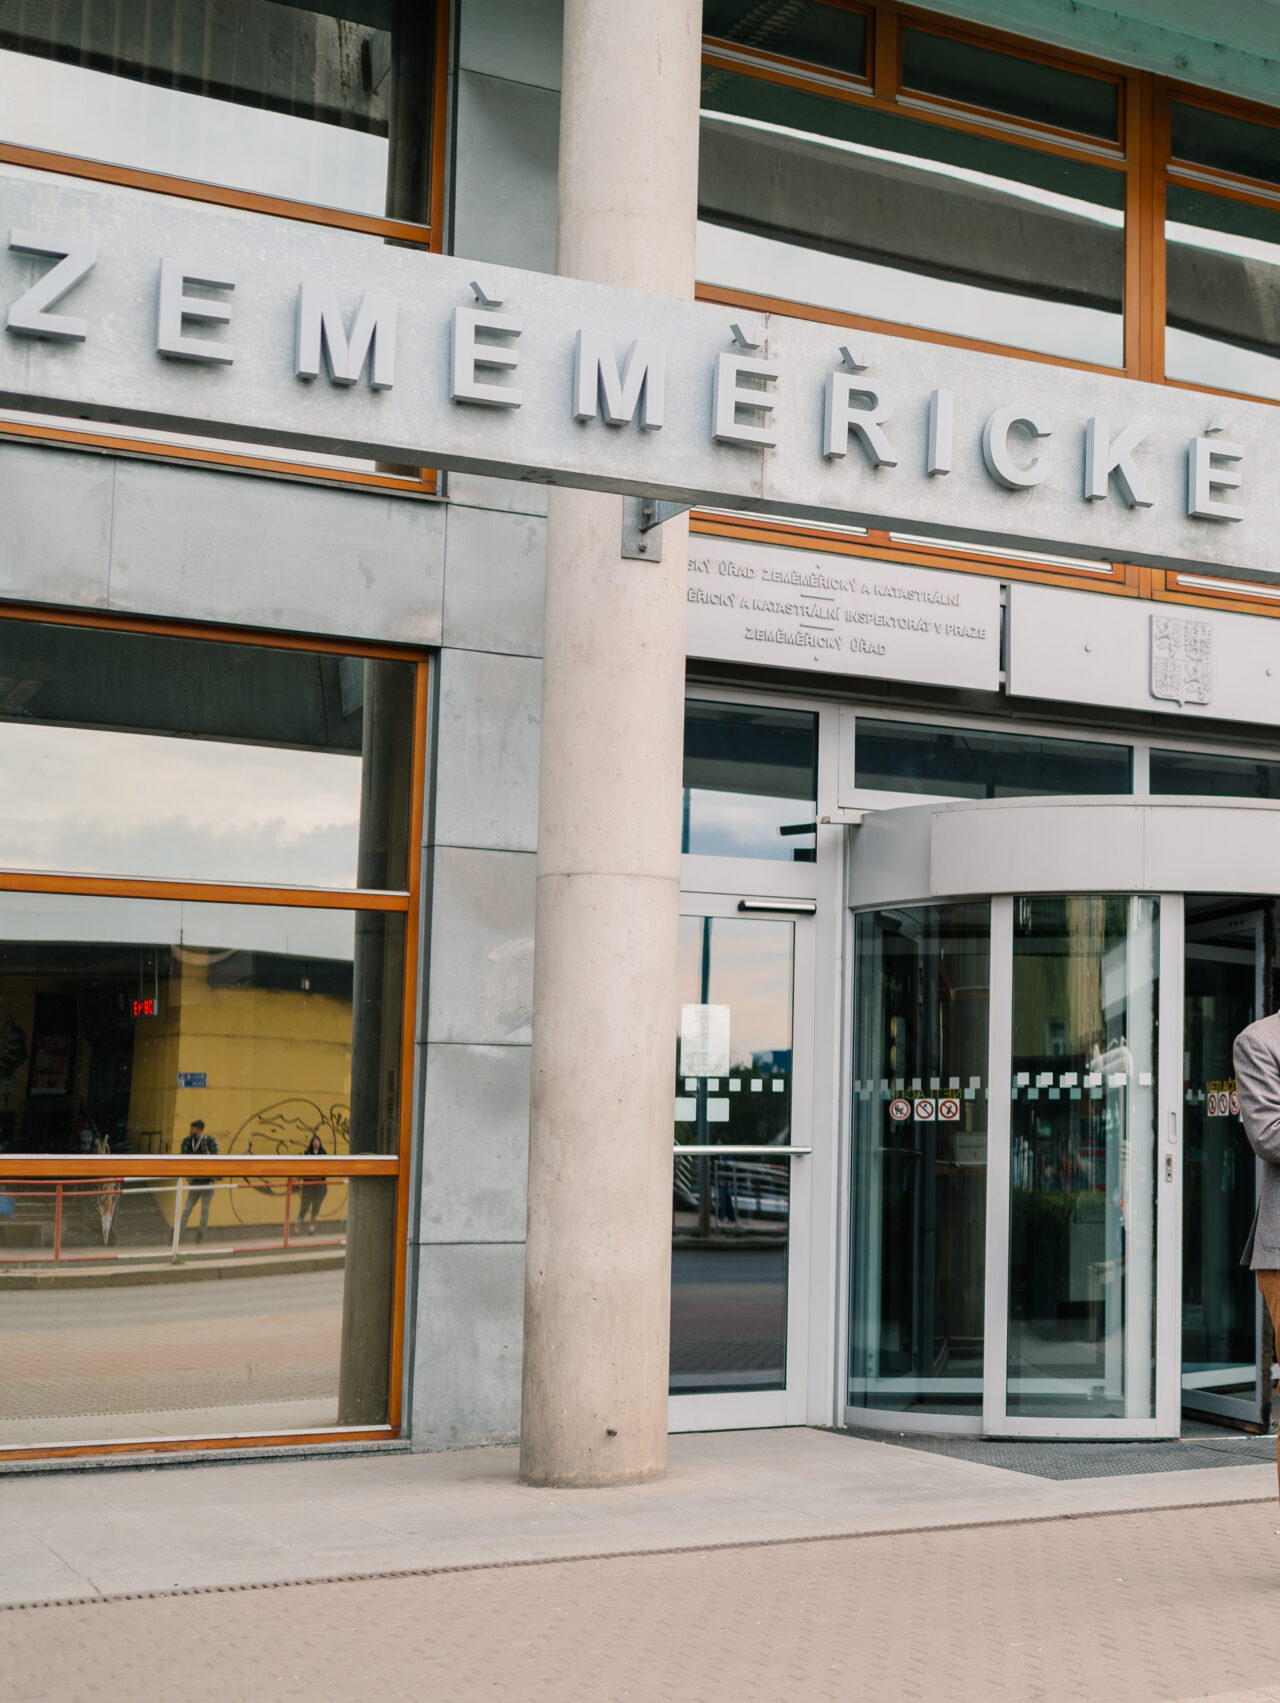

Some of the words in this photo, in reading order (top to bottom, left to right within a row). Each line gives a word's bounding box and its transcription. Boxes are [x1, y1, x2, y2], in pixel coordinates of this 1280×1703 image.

[4, 227, 1246, 525] ZEMĚMĚŘICKÉ
[687, 558, 711, 574] SKÝ
[860, 582, 871, 595] A
[874, 583, 961, 608] KATASTRÁLNÍ
[740, 596, 751, 610] A
[752, 597, 841, 621] KATASTRÁLNÍ
[933, 621, 943, 634] V
[945, 623, 987, 641] PRAZE
